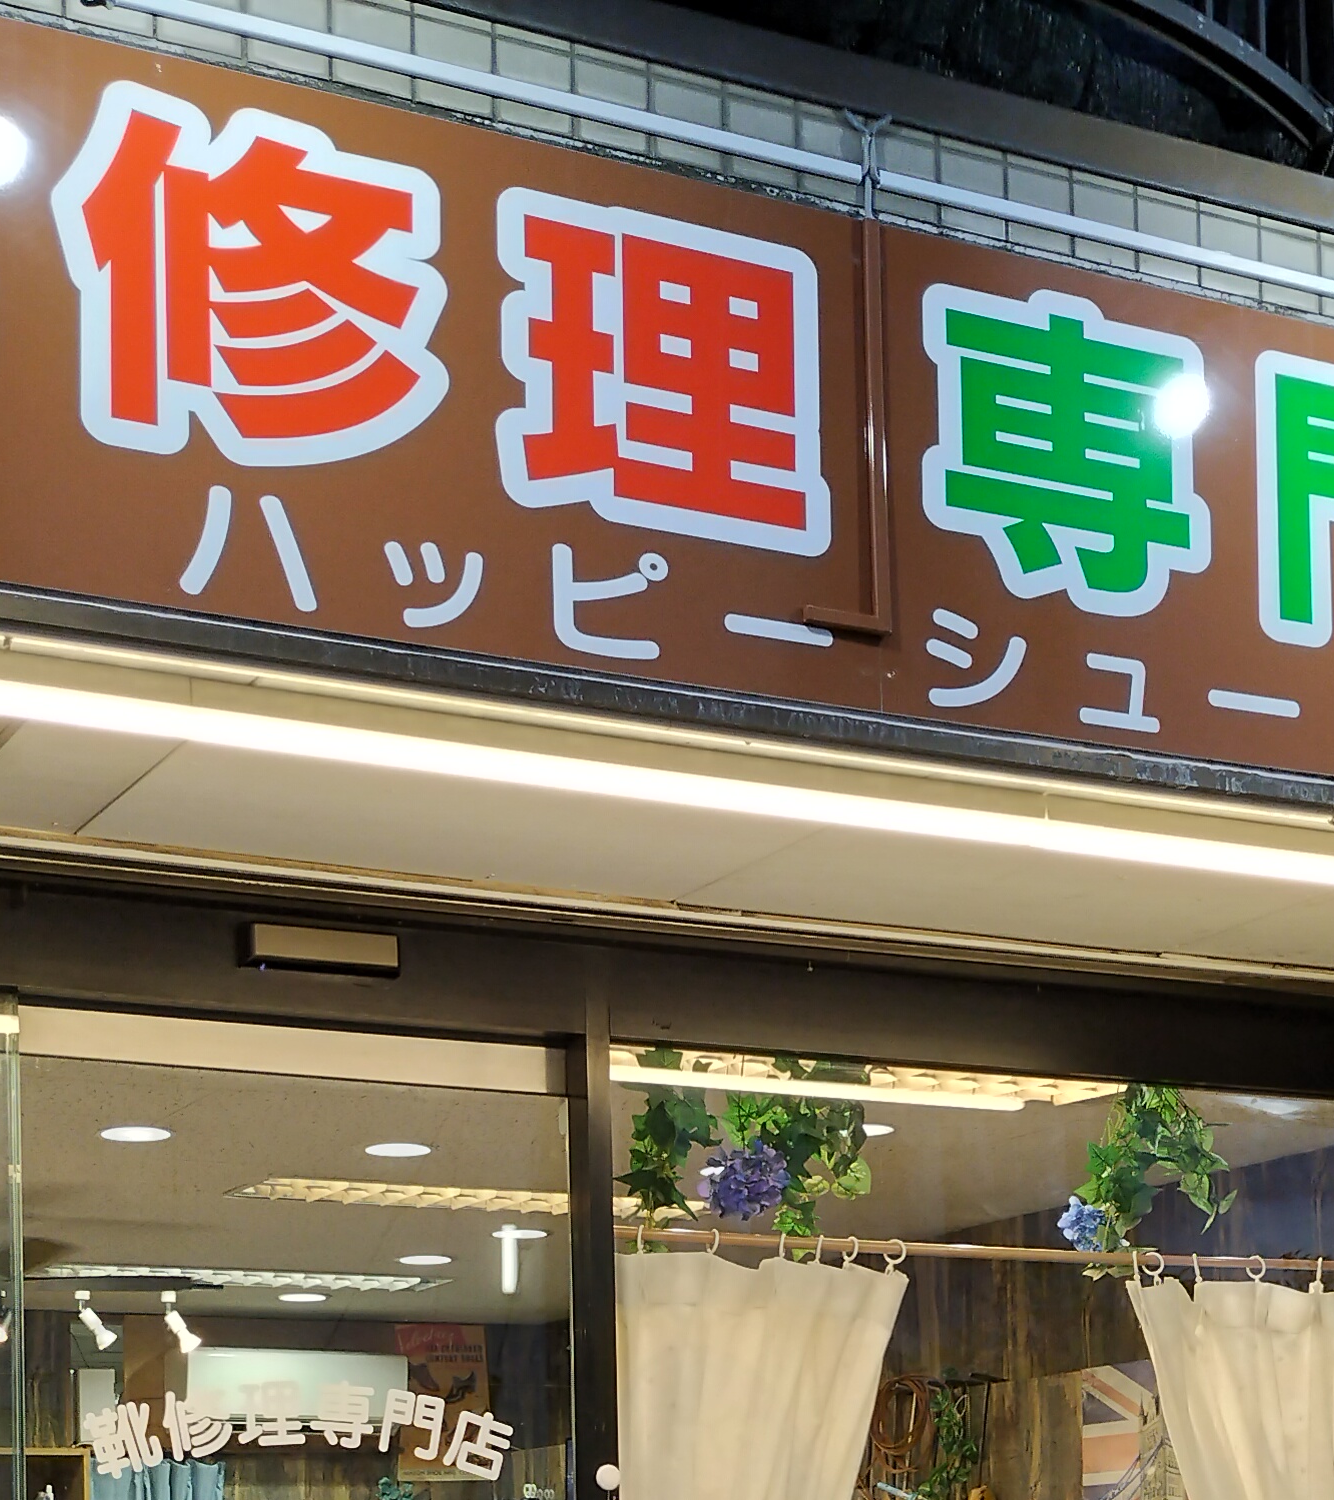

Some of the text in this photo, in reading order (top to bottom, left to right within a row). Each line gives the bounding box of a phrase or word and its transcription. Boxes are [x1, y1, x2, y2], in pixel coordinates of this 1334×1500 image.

[84, 1382, 514, 1481] 靴修理専門店
